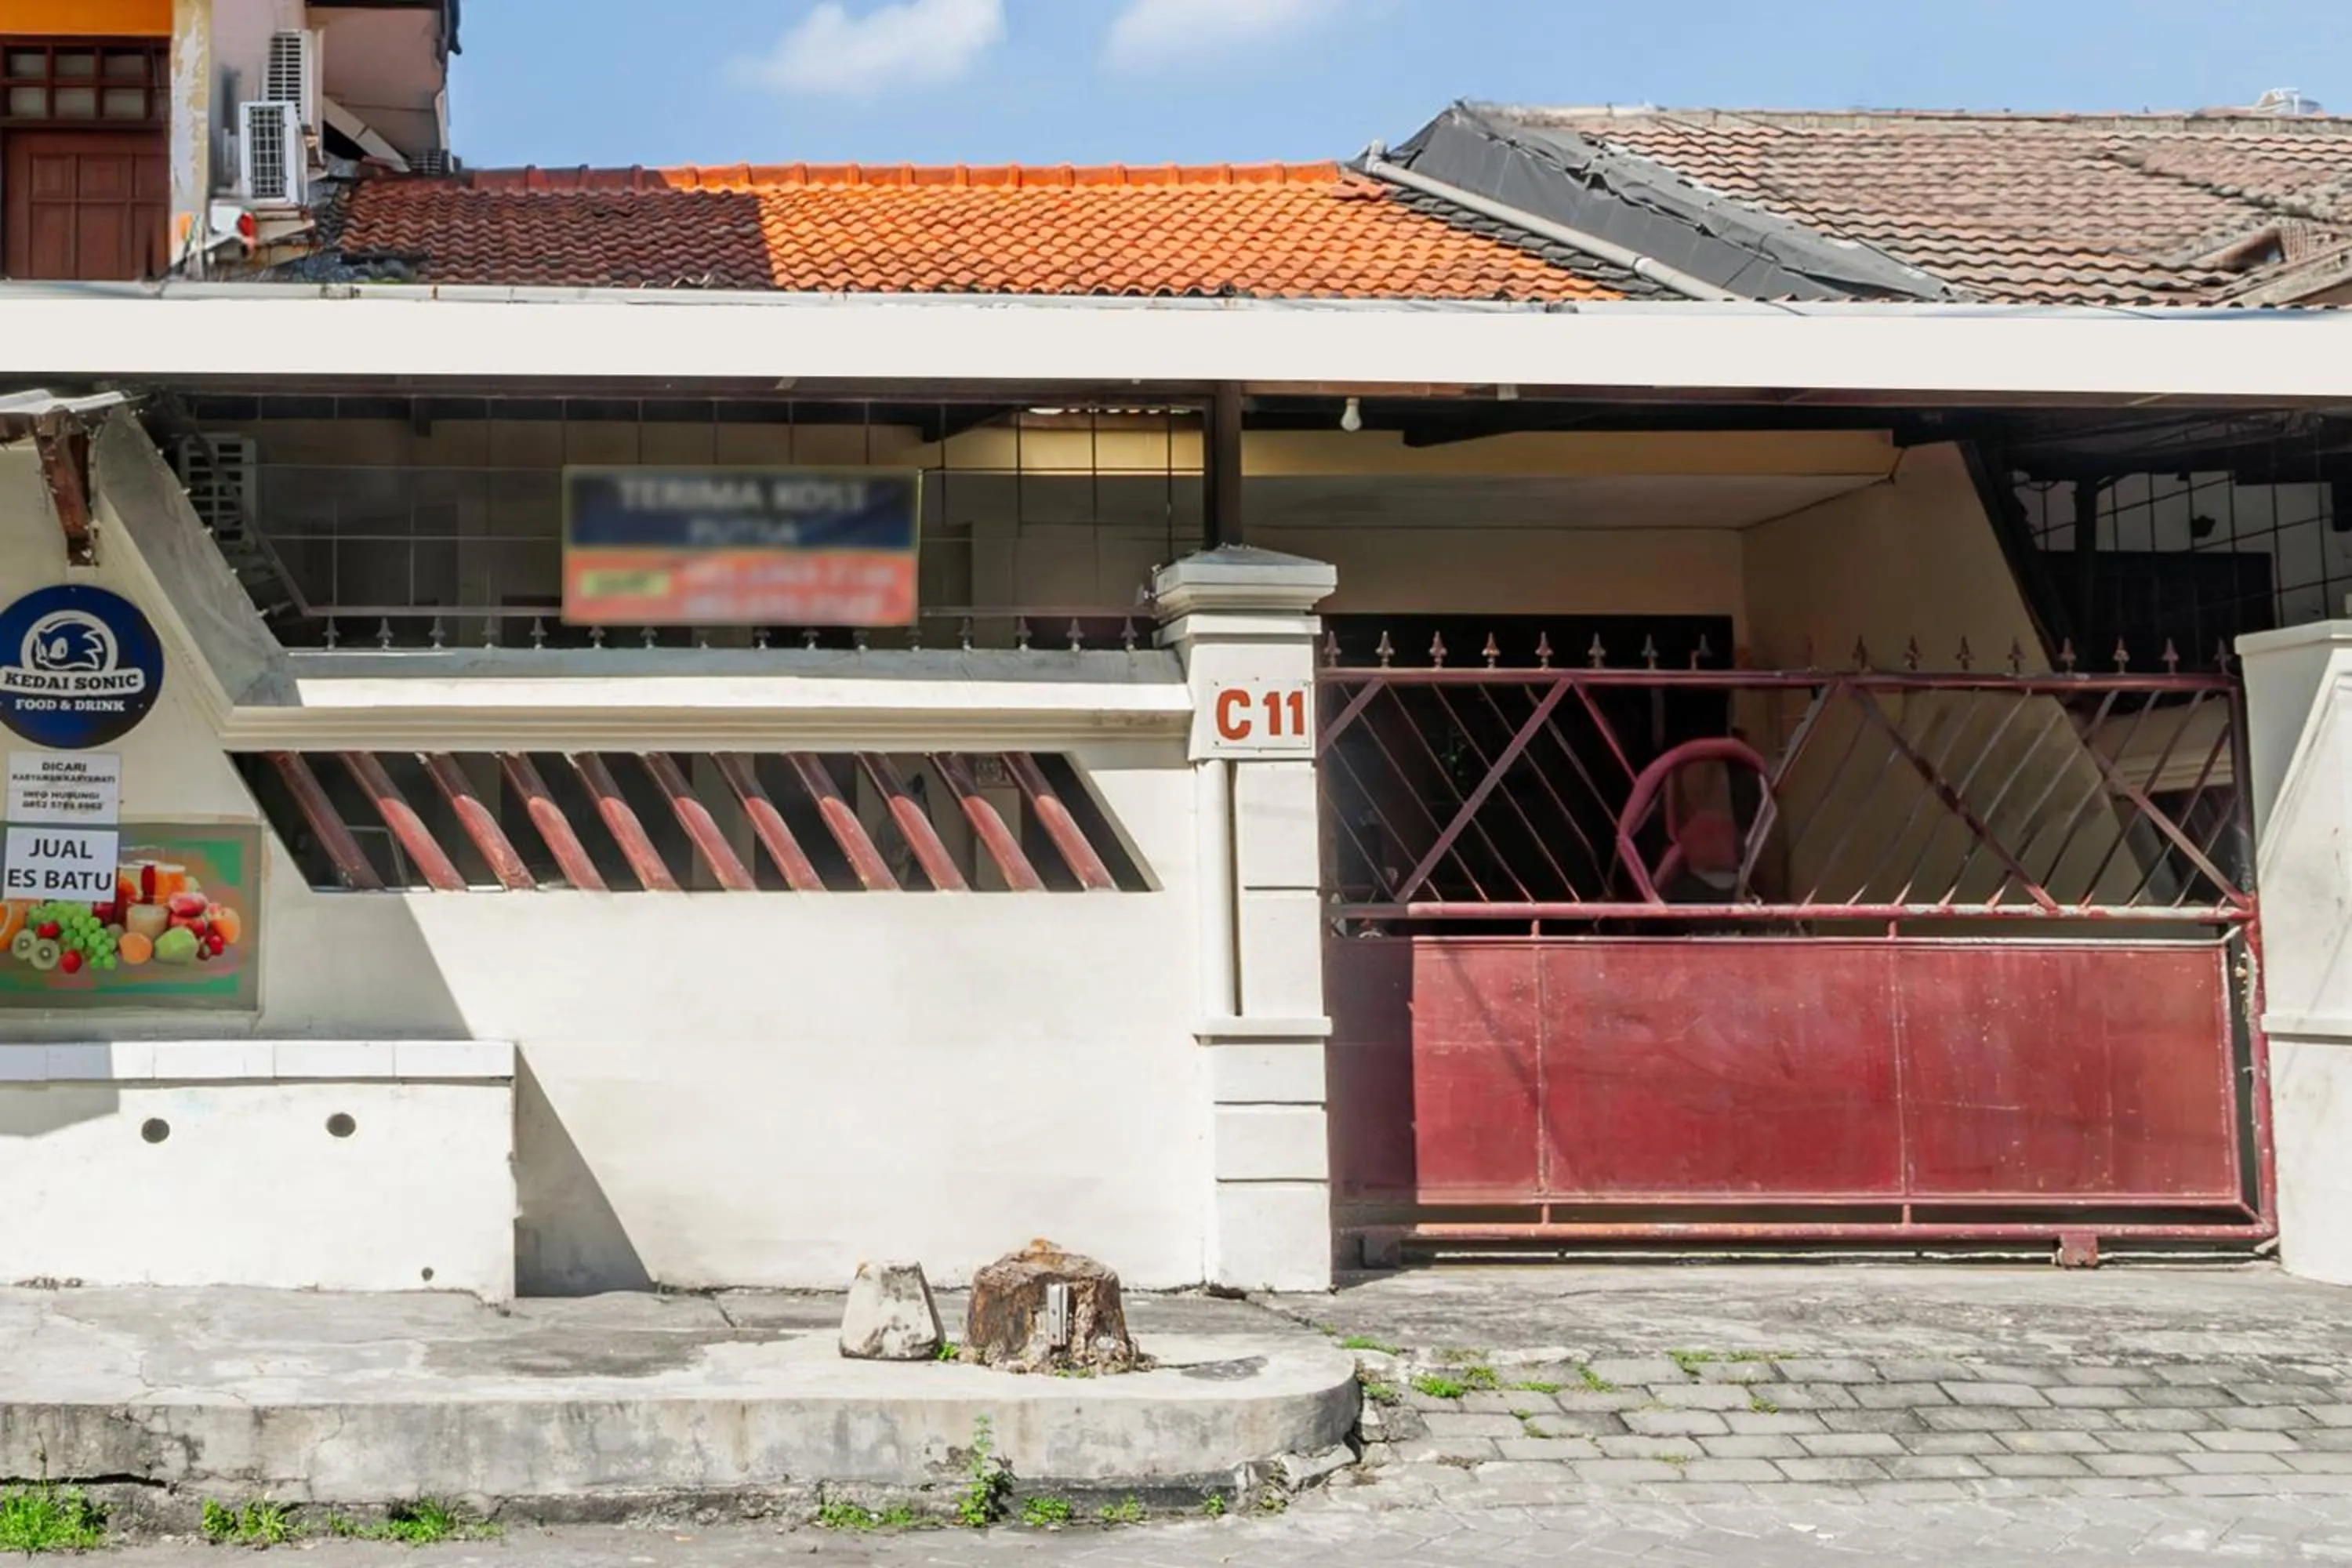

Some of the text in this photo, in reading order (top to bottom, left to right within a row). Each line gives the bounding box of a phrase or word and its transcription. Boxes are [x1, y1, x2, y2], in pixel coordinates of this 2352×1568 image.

[5, 671, 139, 690] KEDAI SONIC
[15, 699, 125, 712] FOOD & DRINK
[1217, 689, 1305, 740] C 11
[42, 761, 87, 772] DICARI
[29, 838, 93, 860] JUAL
[7, 868, 111, 891] ES BATU
